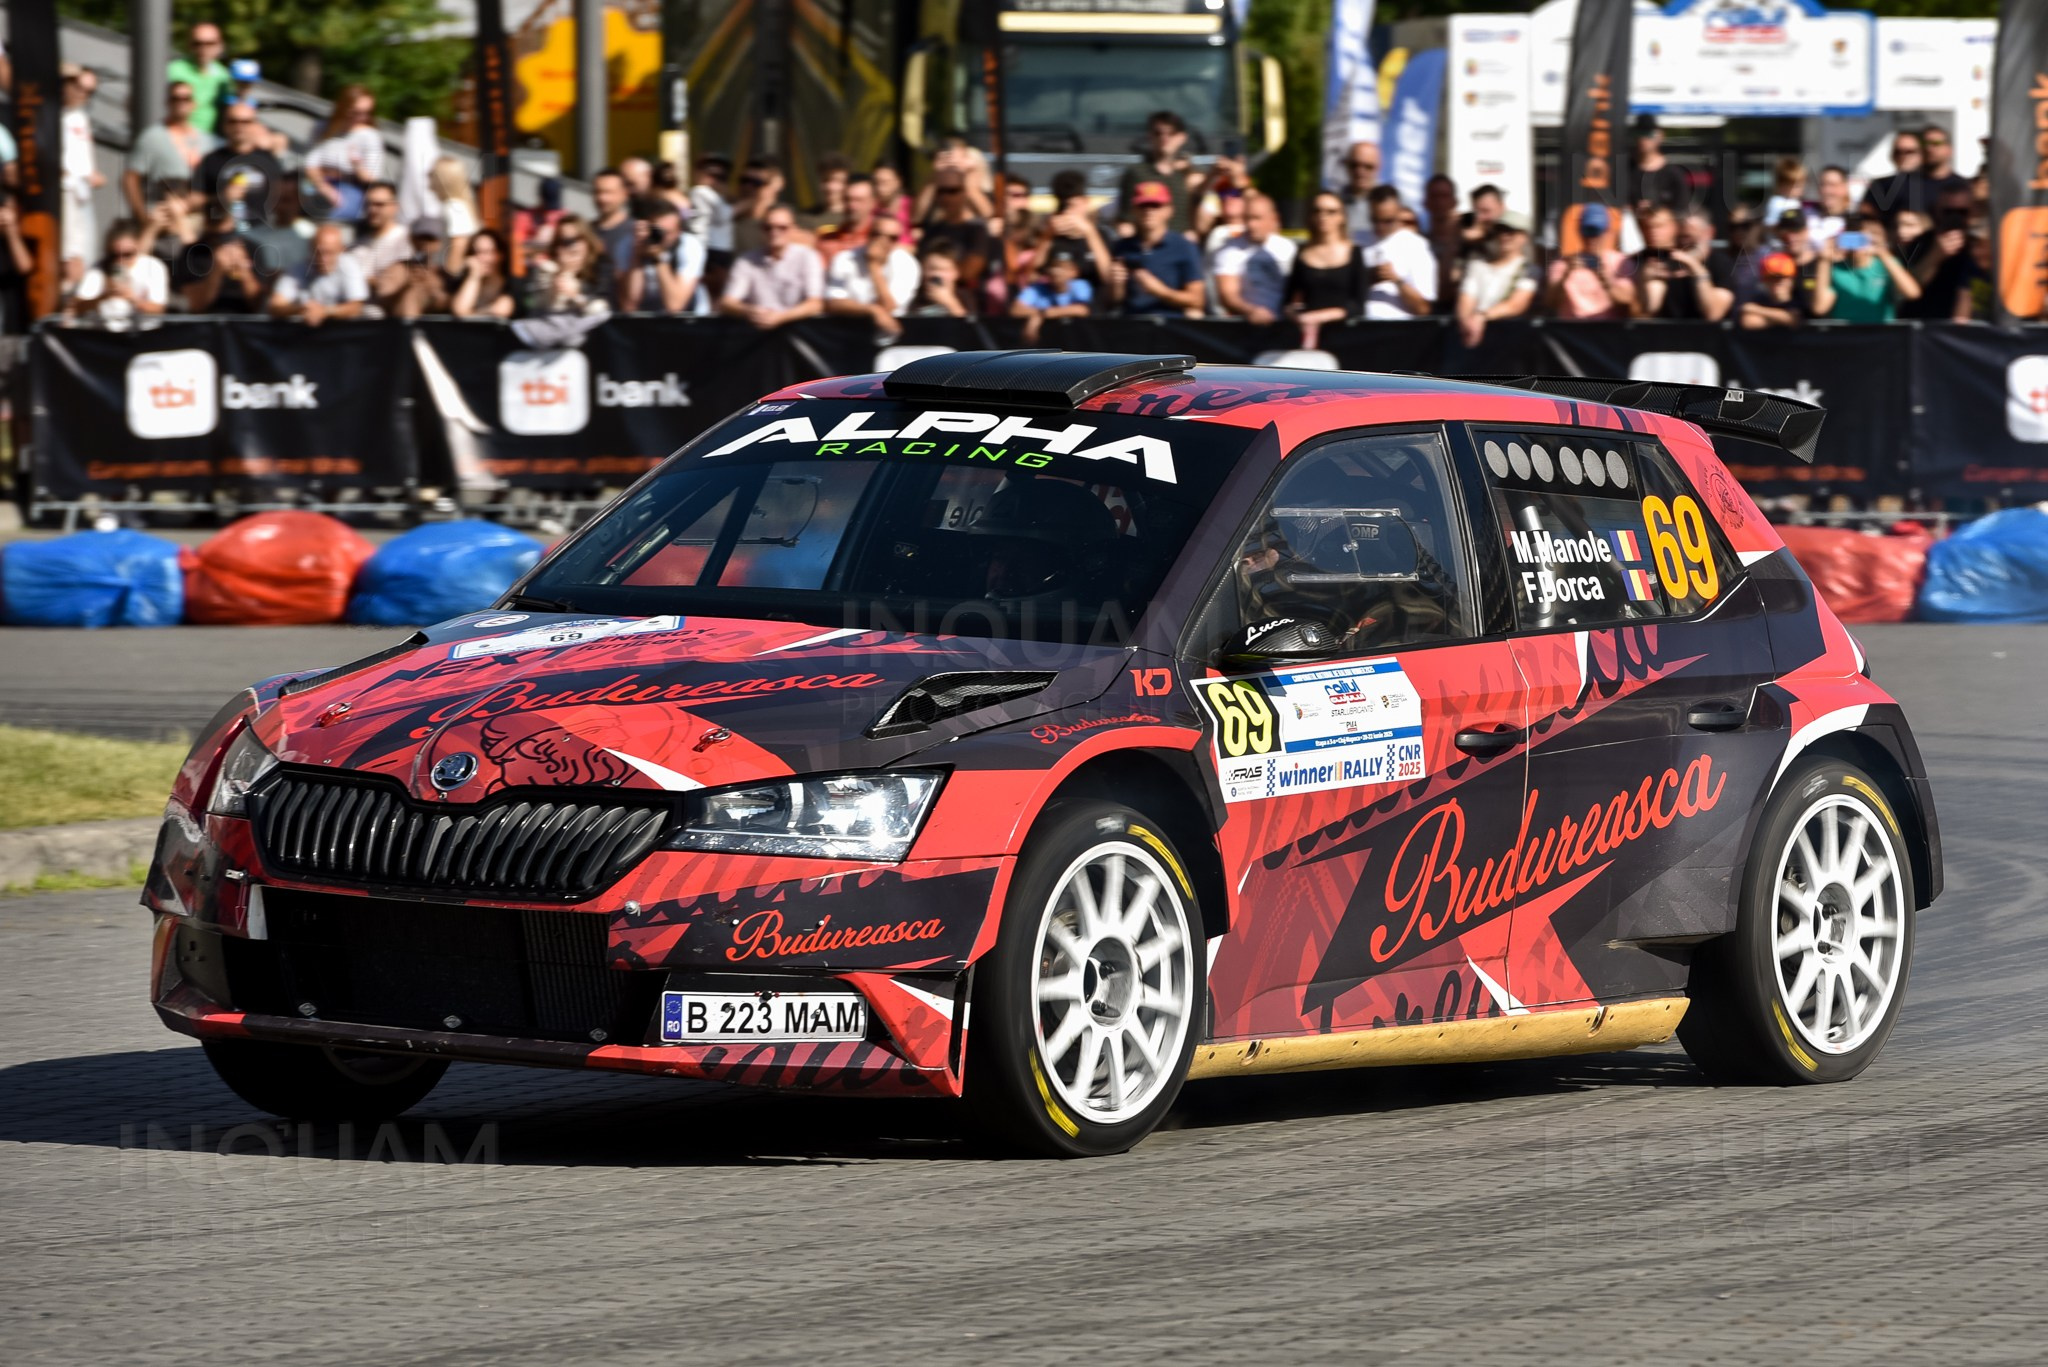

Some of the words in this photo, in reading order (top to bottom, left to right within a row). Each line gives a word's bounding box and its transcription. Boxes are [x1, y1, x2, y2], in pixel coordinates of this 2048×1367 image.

[149, 377, 195, 409] tbi
[222, 374, 319, 409] bank
[520, 375, 568, 406] tbi
[596, 373, 691, 407] bank
[702, 411, 1177, 485] ALPHA
[814, 441, 1054, 469] RACING
[1351, 526, 1379, 538] OMP
[1510, 530, 1612, 564] M.Manole
[1642, 494, 1719, 600] 69
[1521, 569, 1606, 604] F.Dorca
[550, 632, 583, 643] 69
[1245, 617, 1295, 646] Luca
[1324, 679, 1361, 696] raliul
[409, 672, 885, 739] Budureasca
[1207, 680, 1273, 757] 69
[1398, 744, 1421, 762] CNR
[1398, 761, 1421, 777] 2025
[1233, 766, 1262, 780] FRAS
[1279, 762, 1334, 788] winner
[1343, 756, 1384, 780] RALLY
[1369, 753, 1727, 963] Budureasca
[726, 909, 945, 961] Budureasca
[667, 1021, 680, 1033] RO
[687, 1002, 707, 1034] B
[720, 1002, 772, 1034] 223
[785, 1002, 860, 1034] MAM
